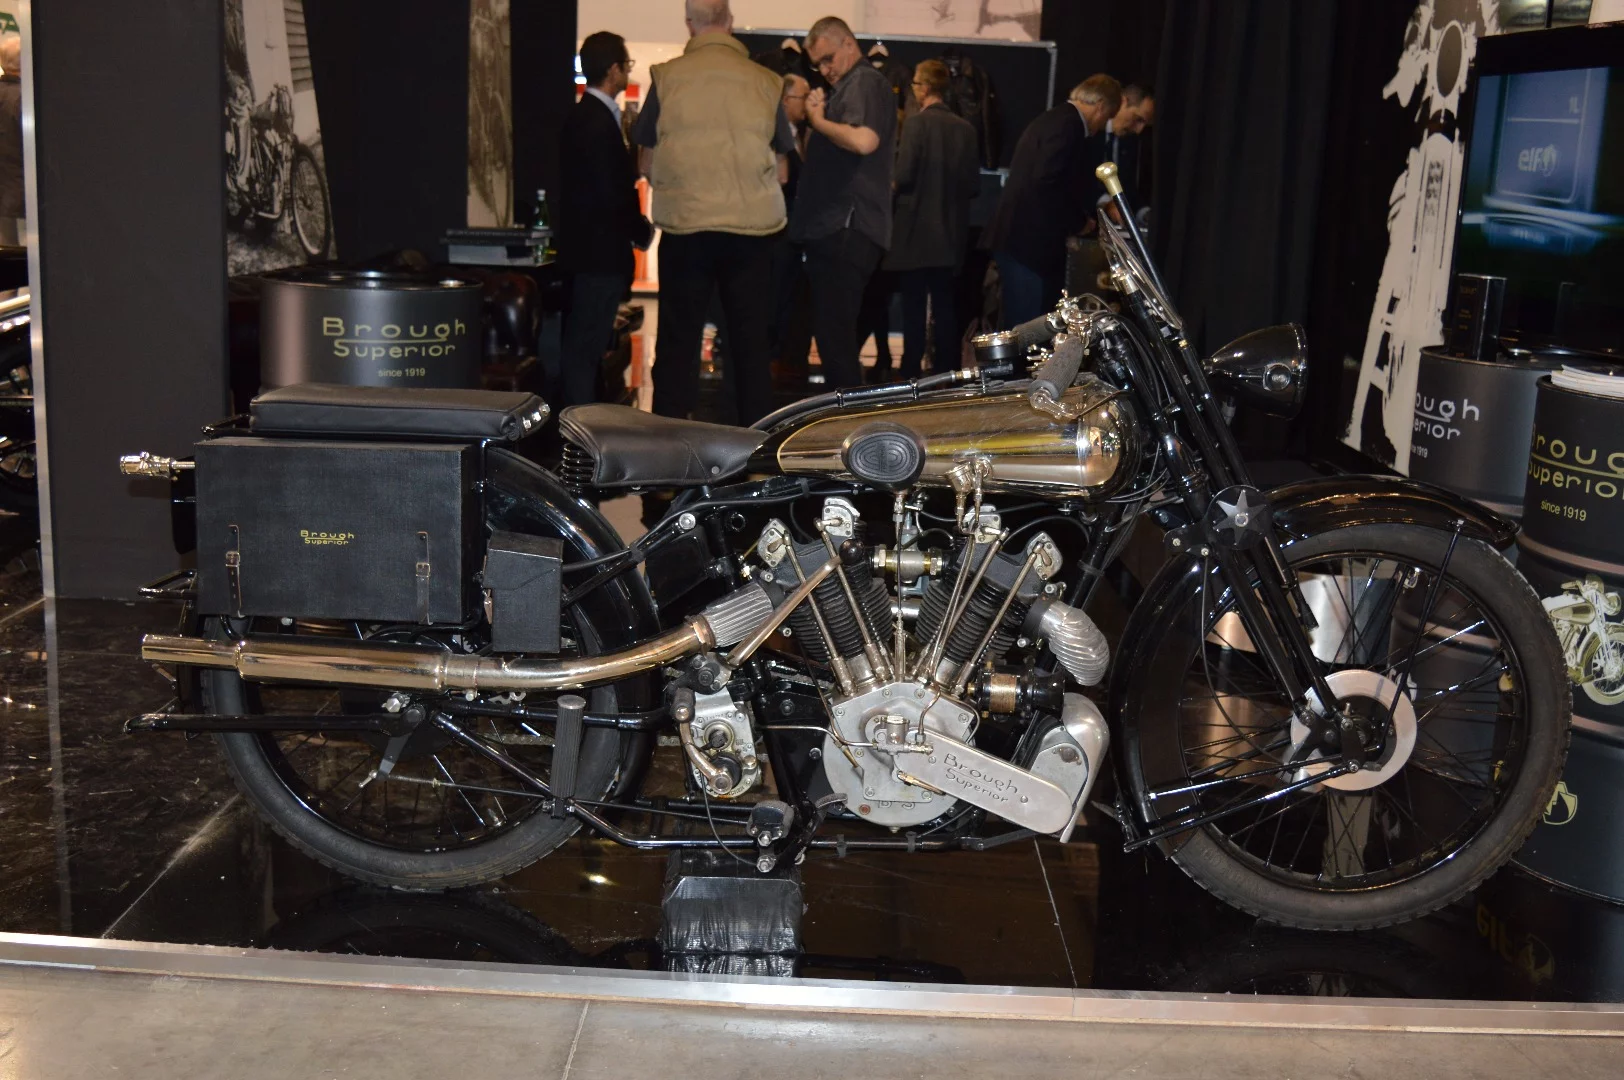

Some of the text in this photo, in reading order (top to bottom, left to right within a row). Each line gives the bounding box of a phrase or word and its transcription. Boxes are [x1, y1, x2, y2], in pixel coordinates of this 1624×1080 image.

[1518, 147, 1543, 172] elf
[322, 316, 467, 341] Brough
[333, 338, 456, 361] Superior
[377, 367, 426, 378] since 1919
[1541, 499, 1587, 522] since 1919
[300, 529, 355, 540] Brough
[304, 537, 349, 546] Superior
[943, 753, 1019, 794] Brough
[945, 767, 1009, 802] Superior
